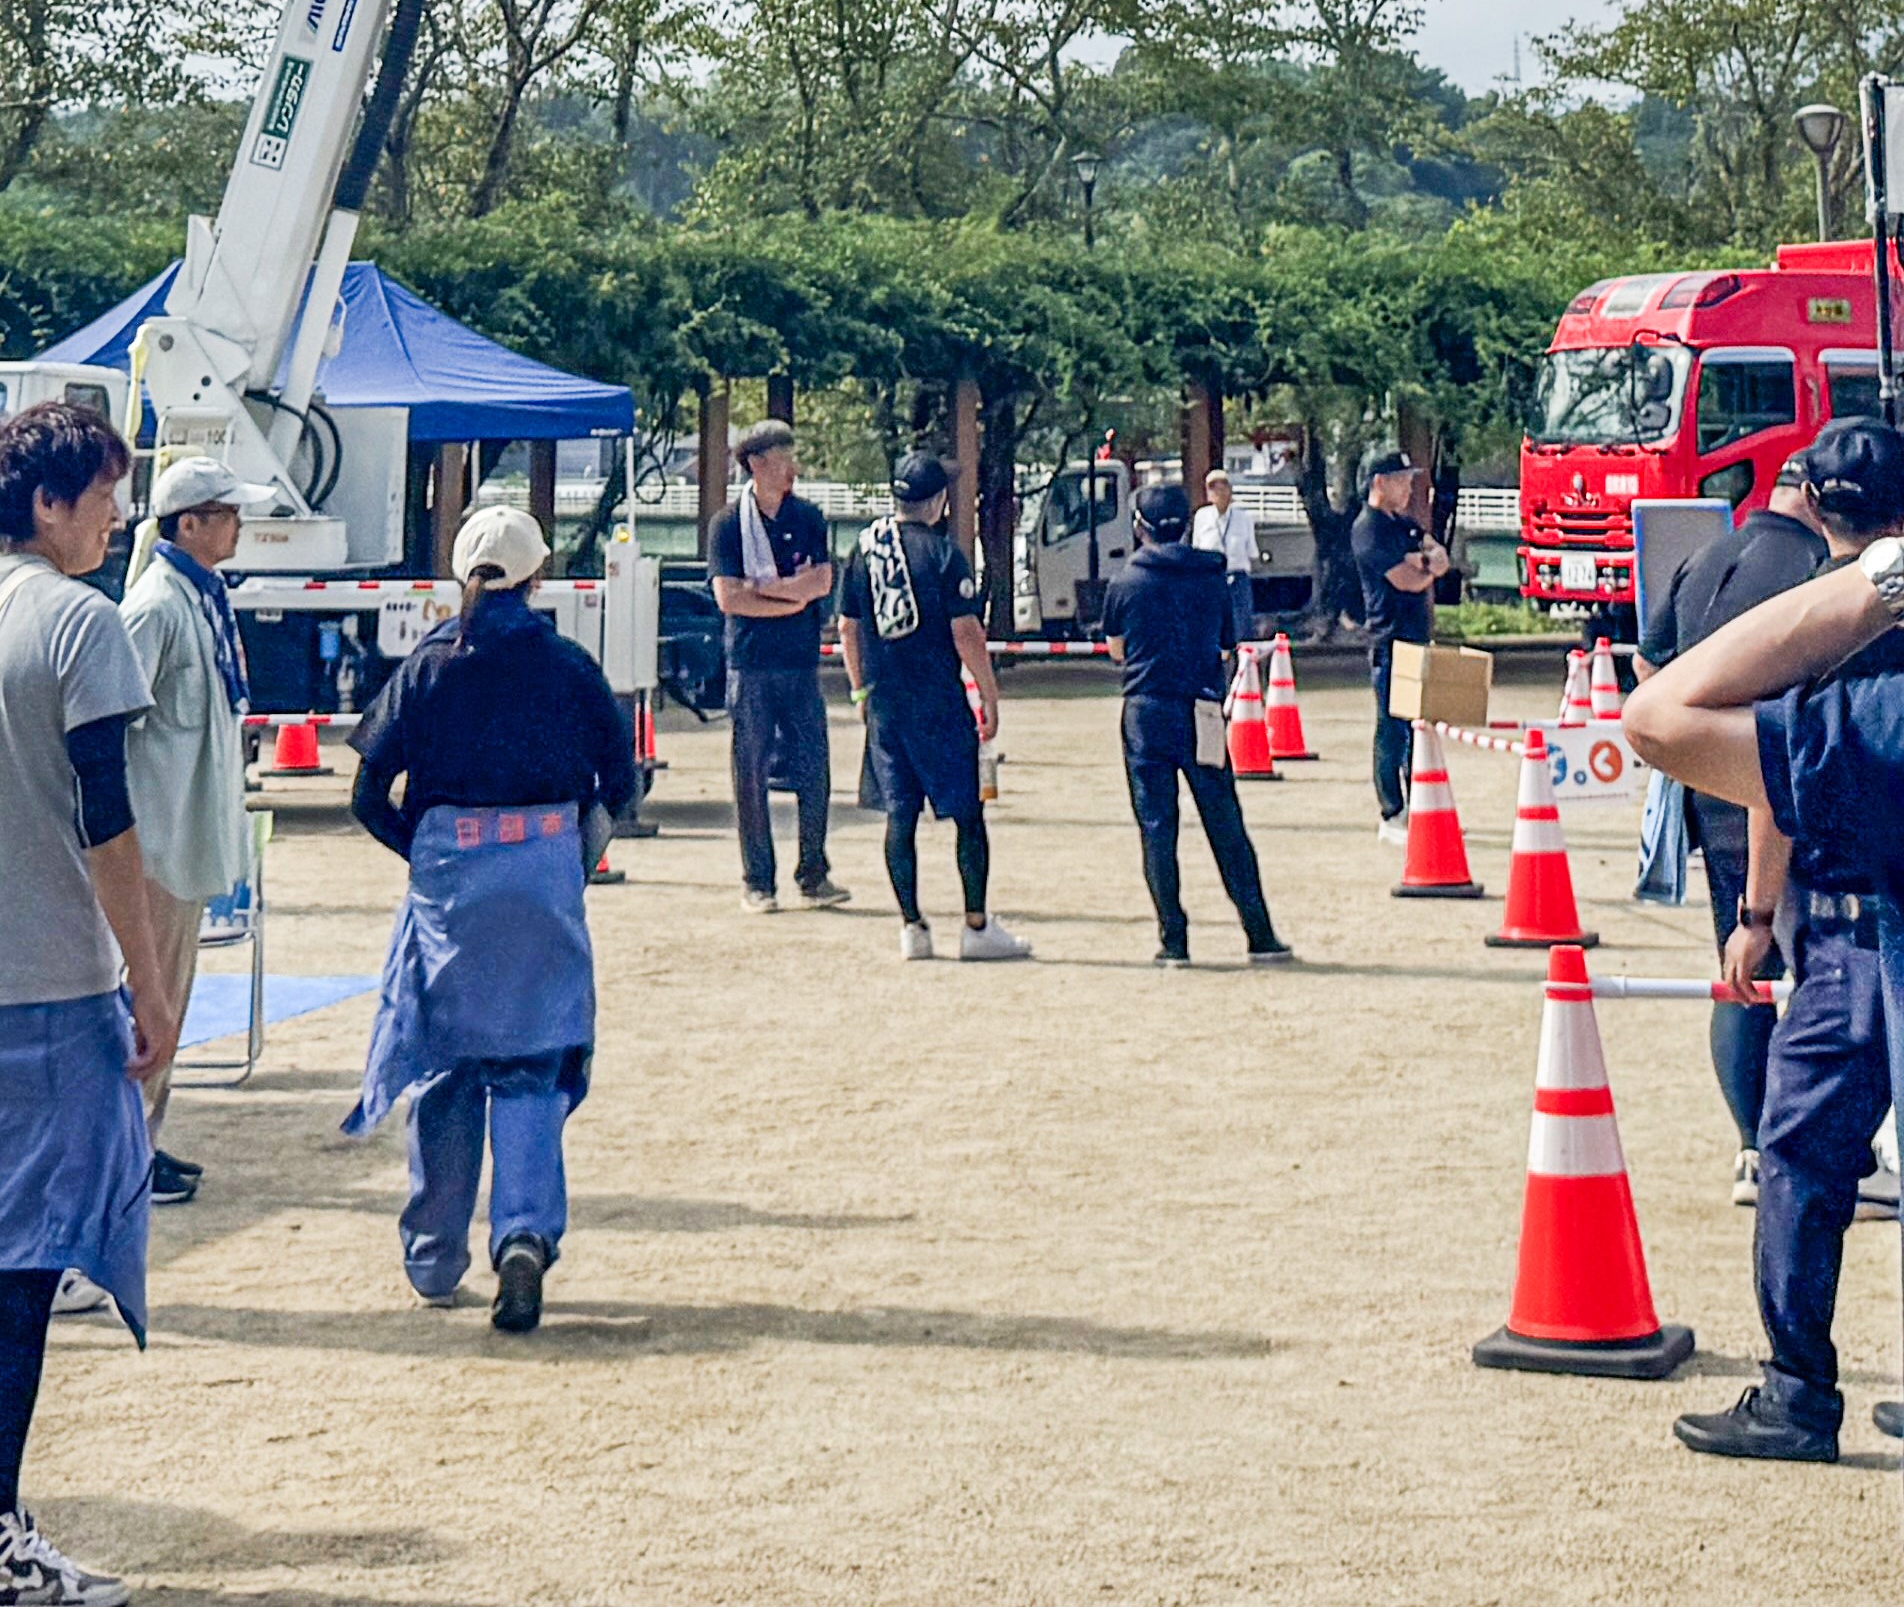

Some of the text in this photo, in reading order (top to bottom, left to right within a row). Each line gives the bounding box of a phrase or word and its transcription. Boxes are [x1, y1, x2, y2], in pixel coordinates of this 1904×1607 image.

[276, 63, 305, 133] レンタカー
